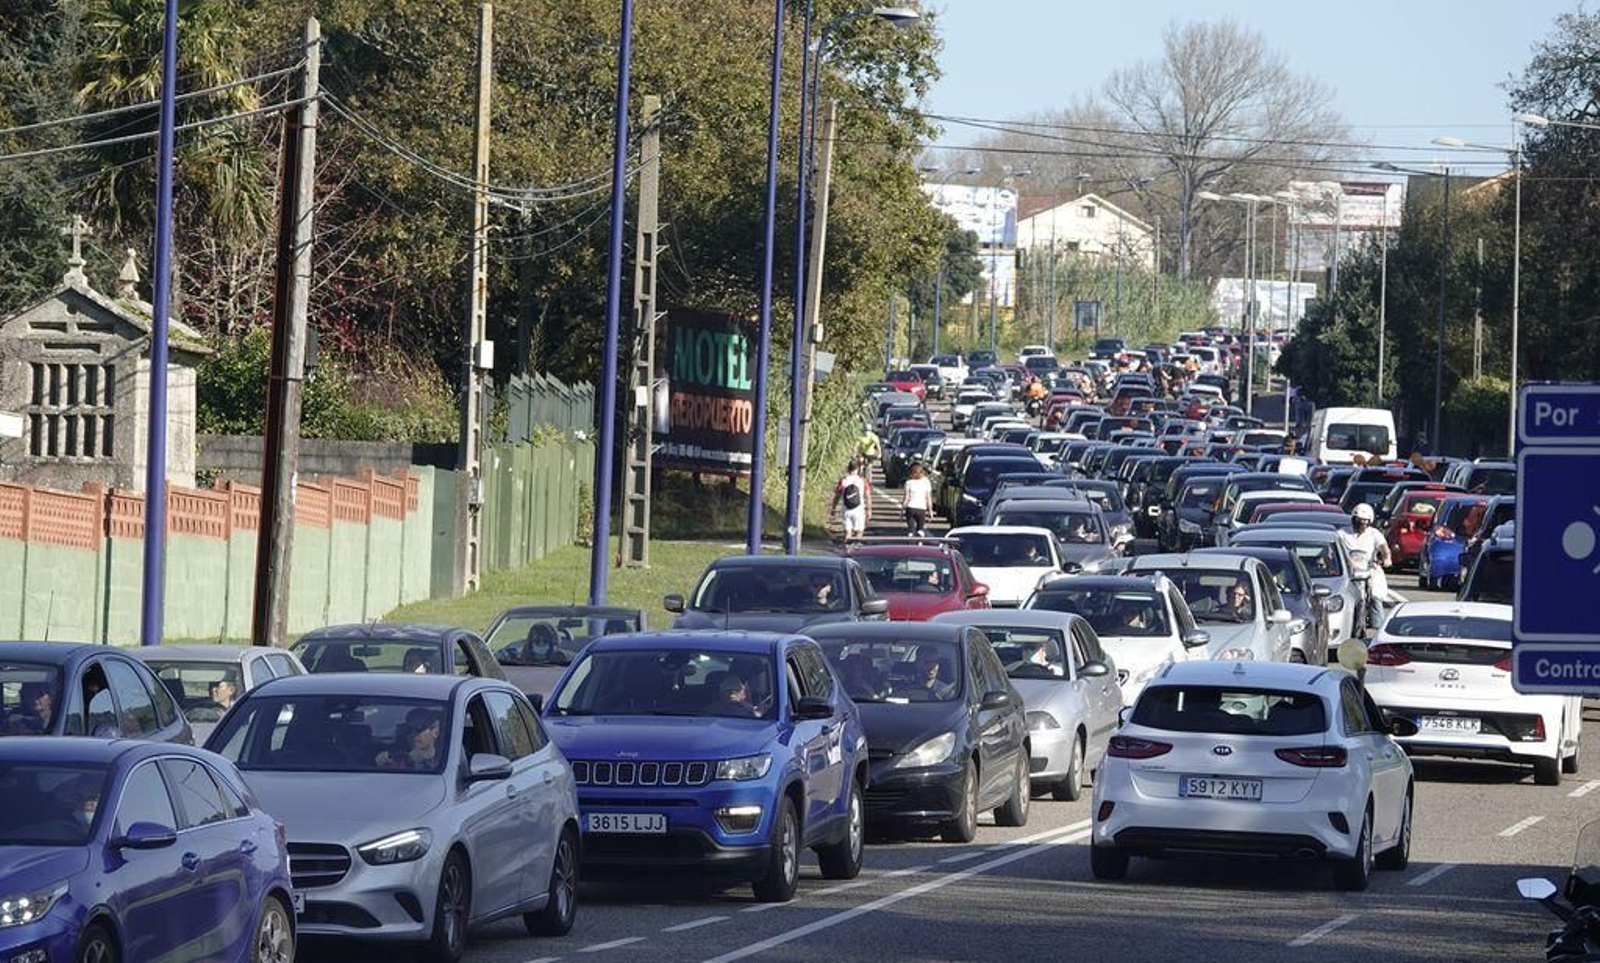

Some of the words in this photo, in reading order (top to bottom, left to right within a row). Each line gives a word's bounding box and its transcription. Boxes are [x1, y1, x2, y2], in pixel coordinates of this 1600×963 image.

[674, 327, 752, 390] MOTEL
[671, 392, 752, 433] AEROPUERTO
[1535, 402, 1579, 426] Por
[1190, 778, 1227, 795] 5912
[1230, 781, 1259, 797] KYY
[592, 815, 629, 830] 3615
[633, 816, 663, 831] LJJ
